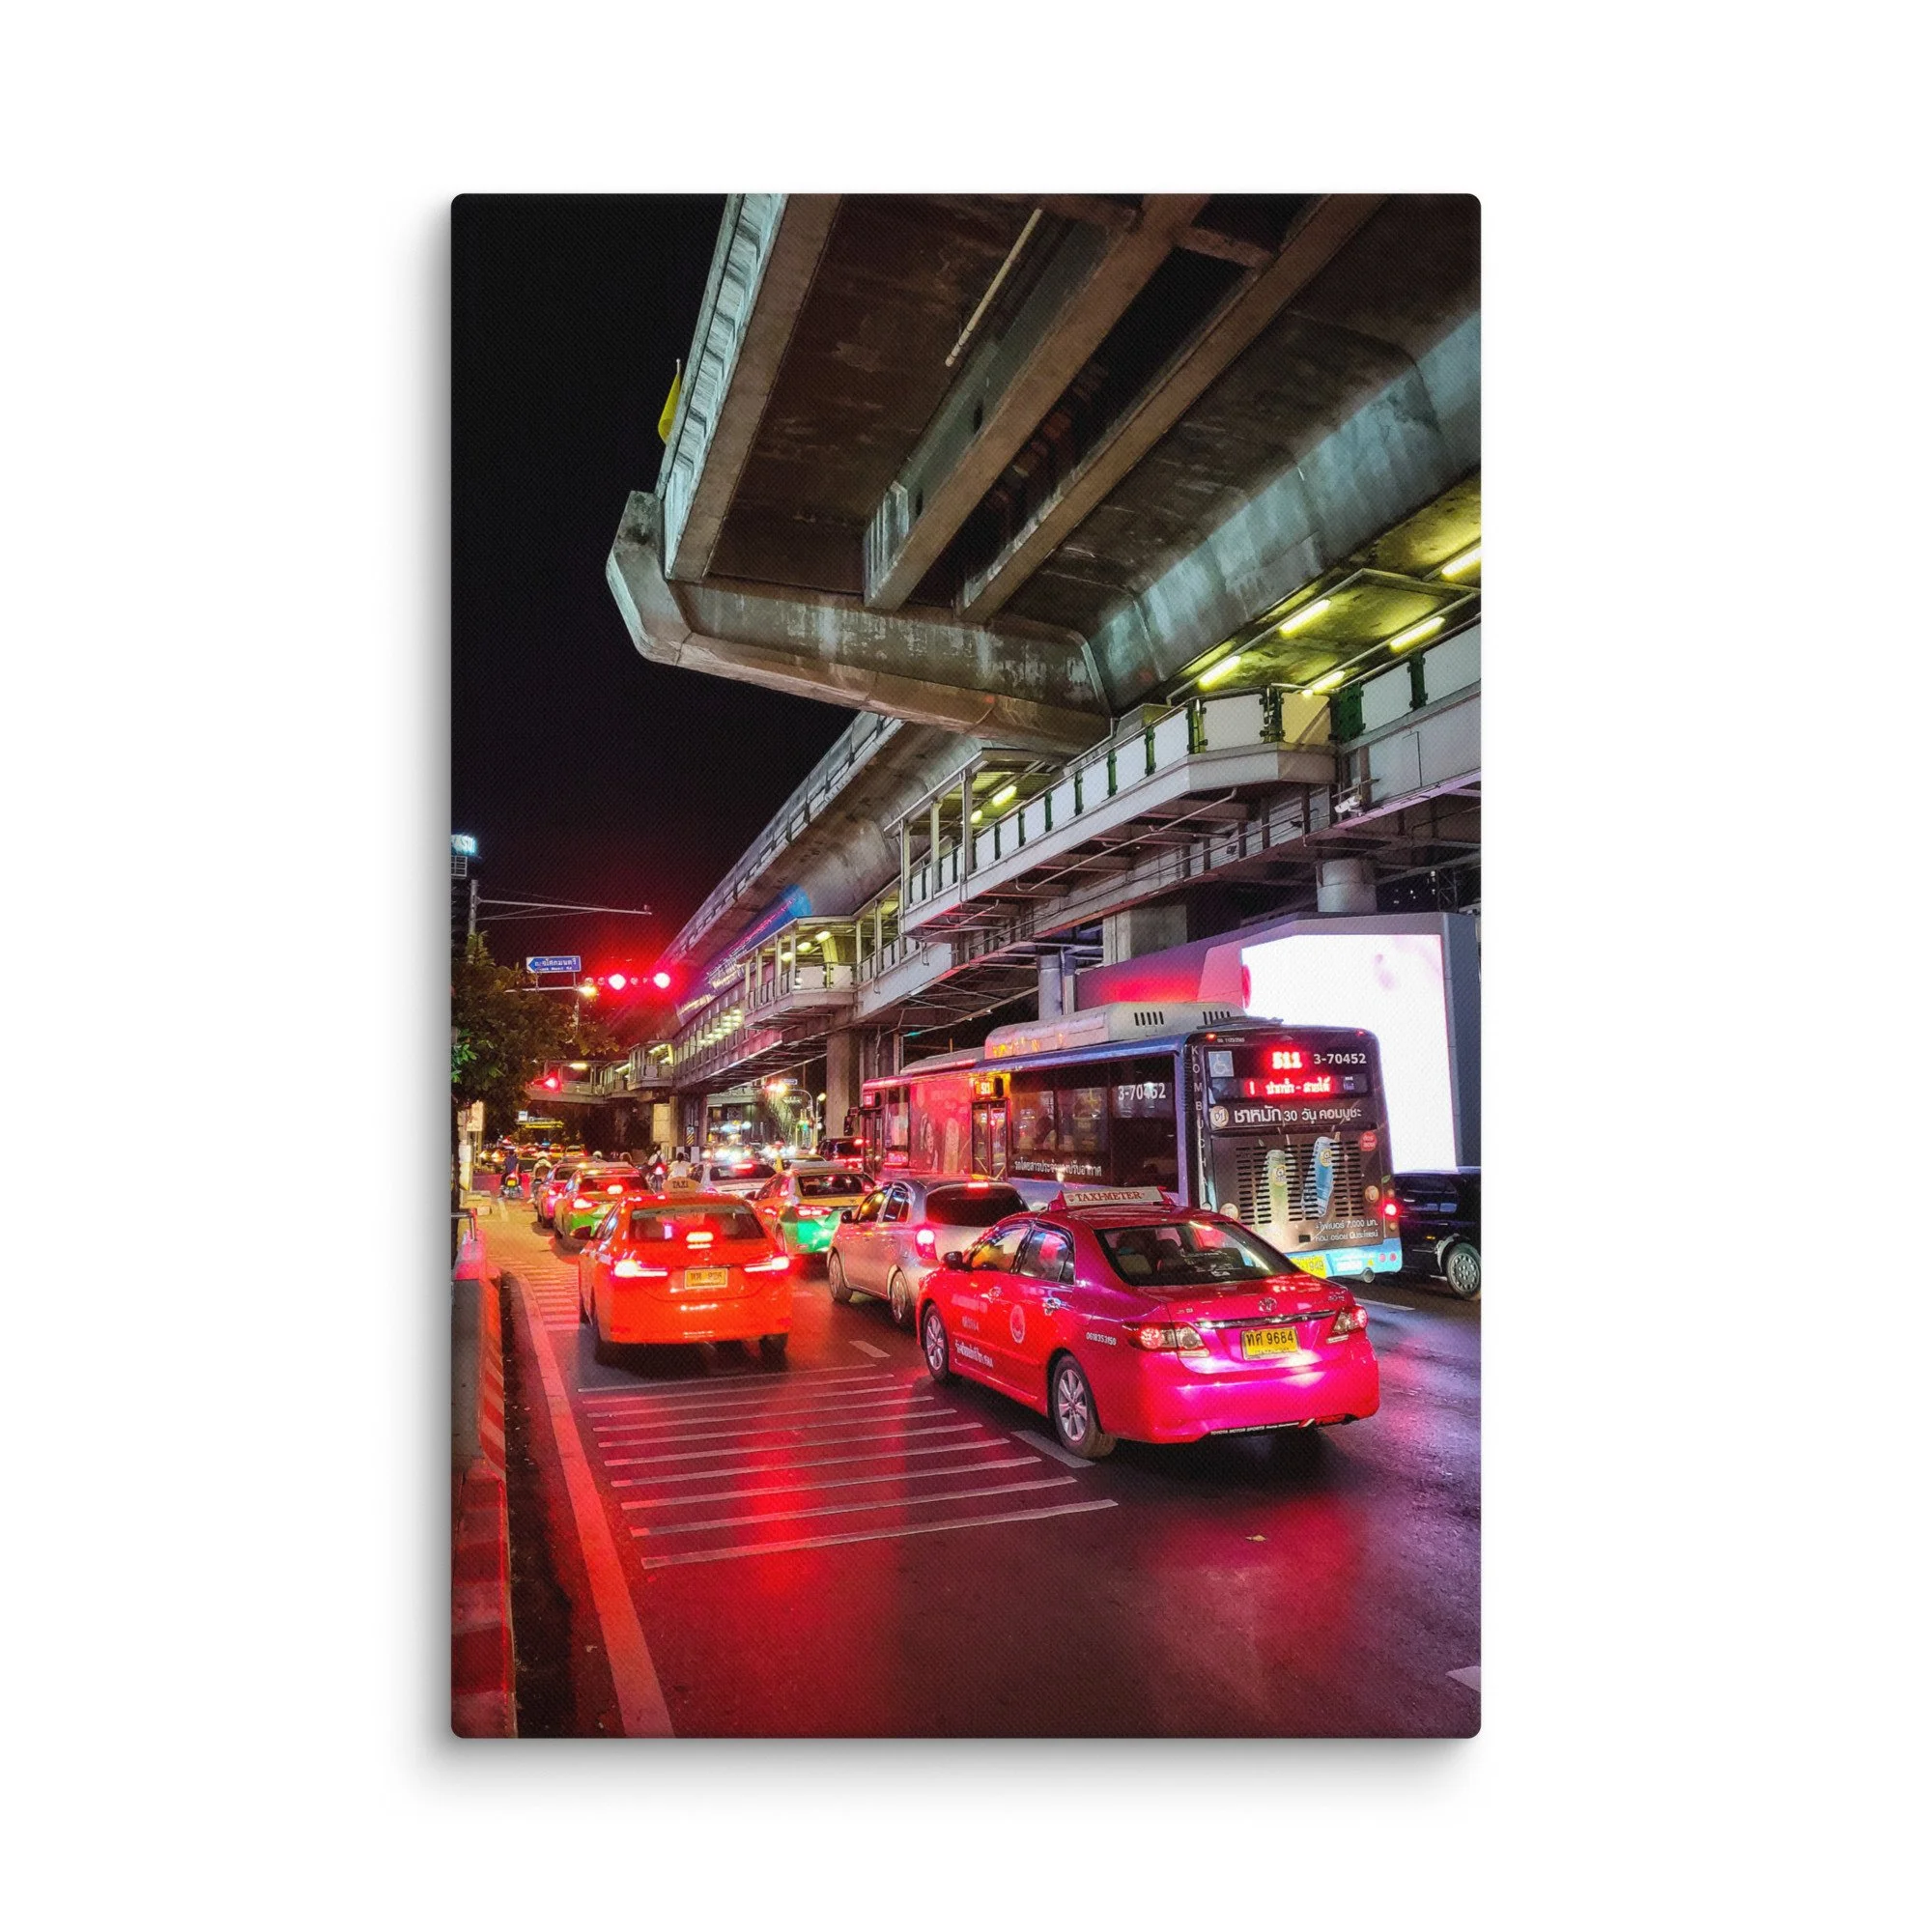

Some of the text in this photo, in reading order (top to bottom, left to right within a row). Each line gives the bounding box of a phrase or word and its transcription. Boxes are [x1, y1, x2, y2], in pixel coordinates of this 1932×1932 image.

[1271, 1051, 1303, 1069] 511
[1313, 1053, 1367, 1065] 3-70452
[1234, 1104, 1282, 1123] ชาหมัก
[1283, 1110, 1298, 1122] 30
[1319, 1108, 1362, 1121] คอมบูชะ
[671, 1179, 689, 1189] TAXI
[1074, 1190, 1142, 1203] TAXI-METER
